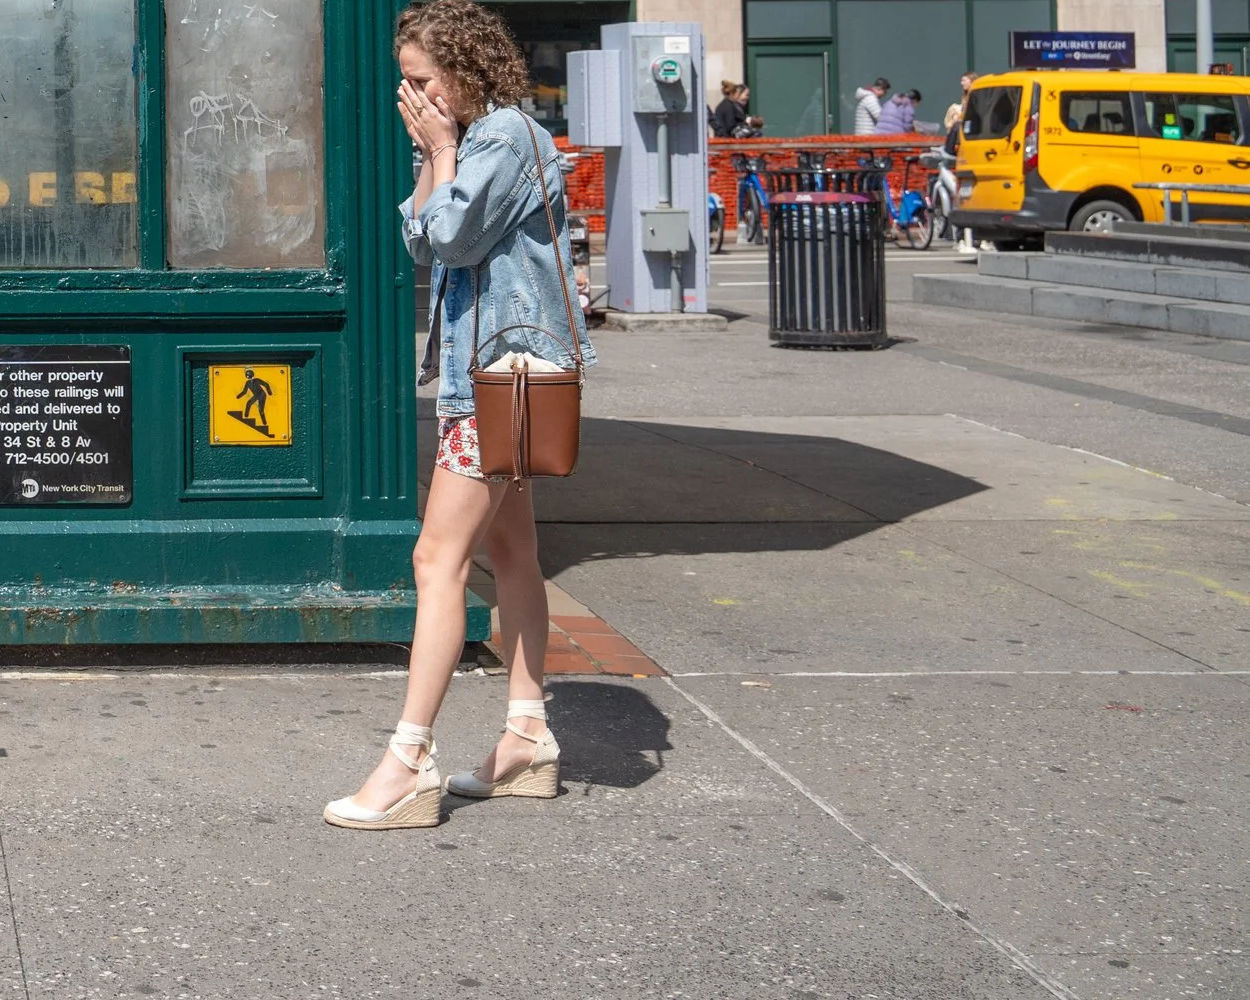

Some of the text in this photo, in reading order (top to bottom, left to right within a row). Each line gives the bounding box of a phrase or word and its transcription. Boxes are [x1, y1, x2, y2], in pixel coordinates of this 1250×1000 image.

[1023, 40, 1041, 50] LET
[1052, 40, 1096, 51] JOURNEY
[1097, 40, 1126, 50] BEGIN
[10, 370, 43, 381] other
[48, 370, 103, 383] property
[13, 387, 49, 397] these
[55, 386, 98, 399] railings
[104, 386, 123, 397] will
[15, 403, 38, 414] and
[44, 403, 102, 414] delivered
[107, 403, 120, 414] to
[53, 420, 77, 431] Unit
[4, 436, 21, 447] 34
[27, 436, 41, 447] St
[46, 436, 55, 447] &
[62, 436, 70, 447] 8
[76, 436, 91, 447] Av
[5, 452, 108, 464] 712-4500/4501
[42, 484, 124, 494] New York City Transit
